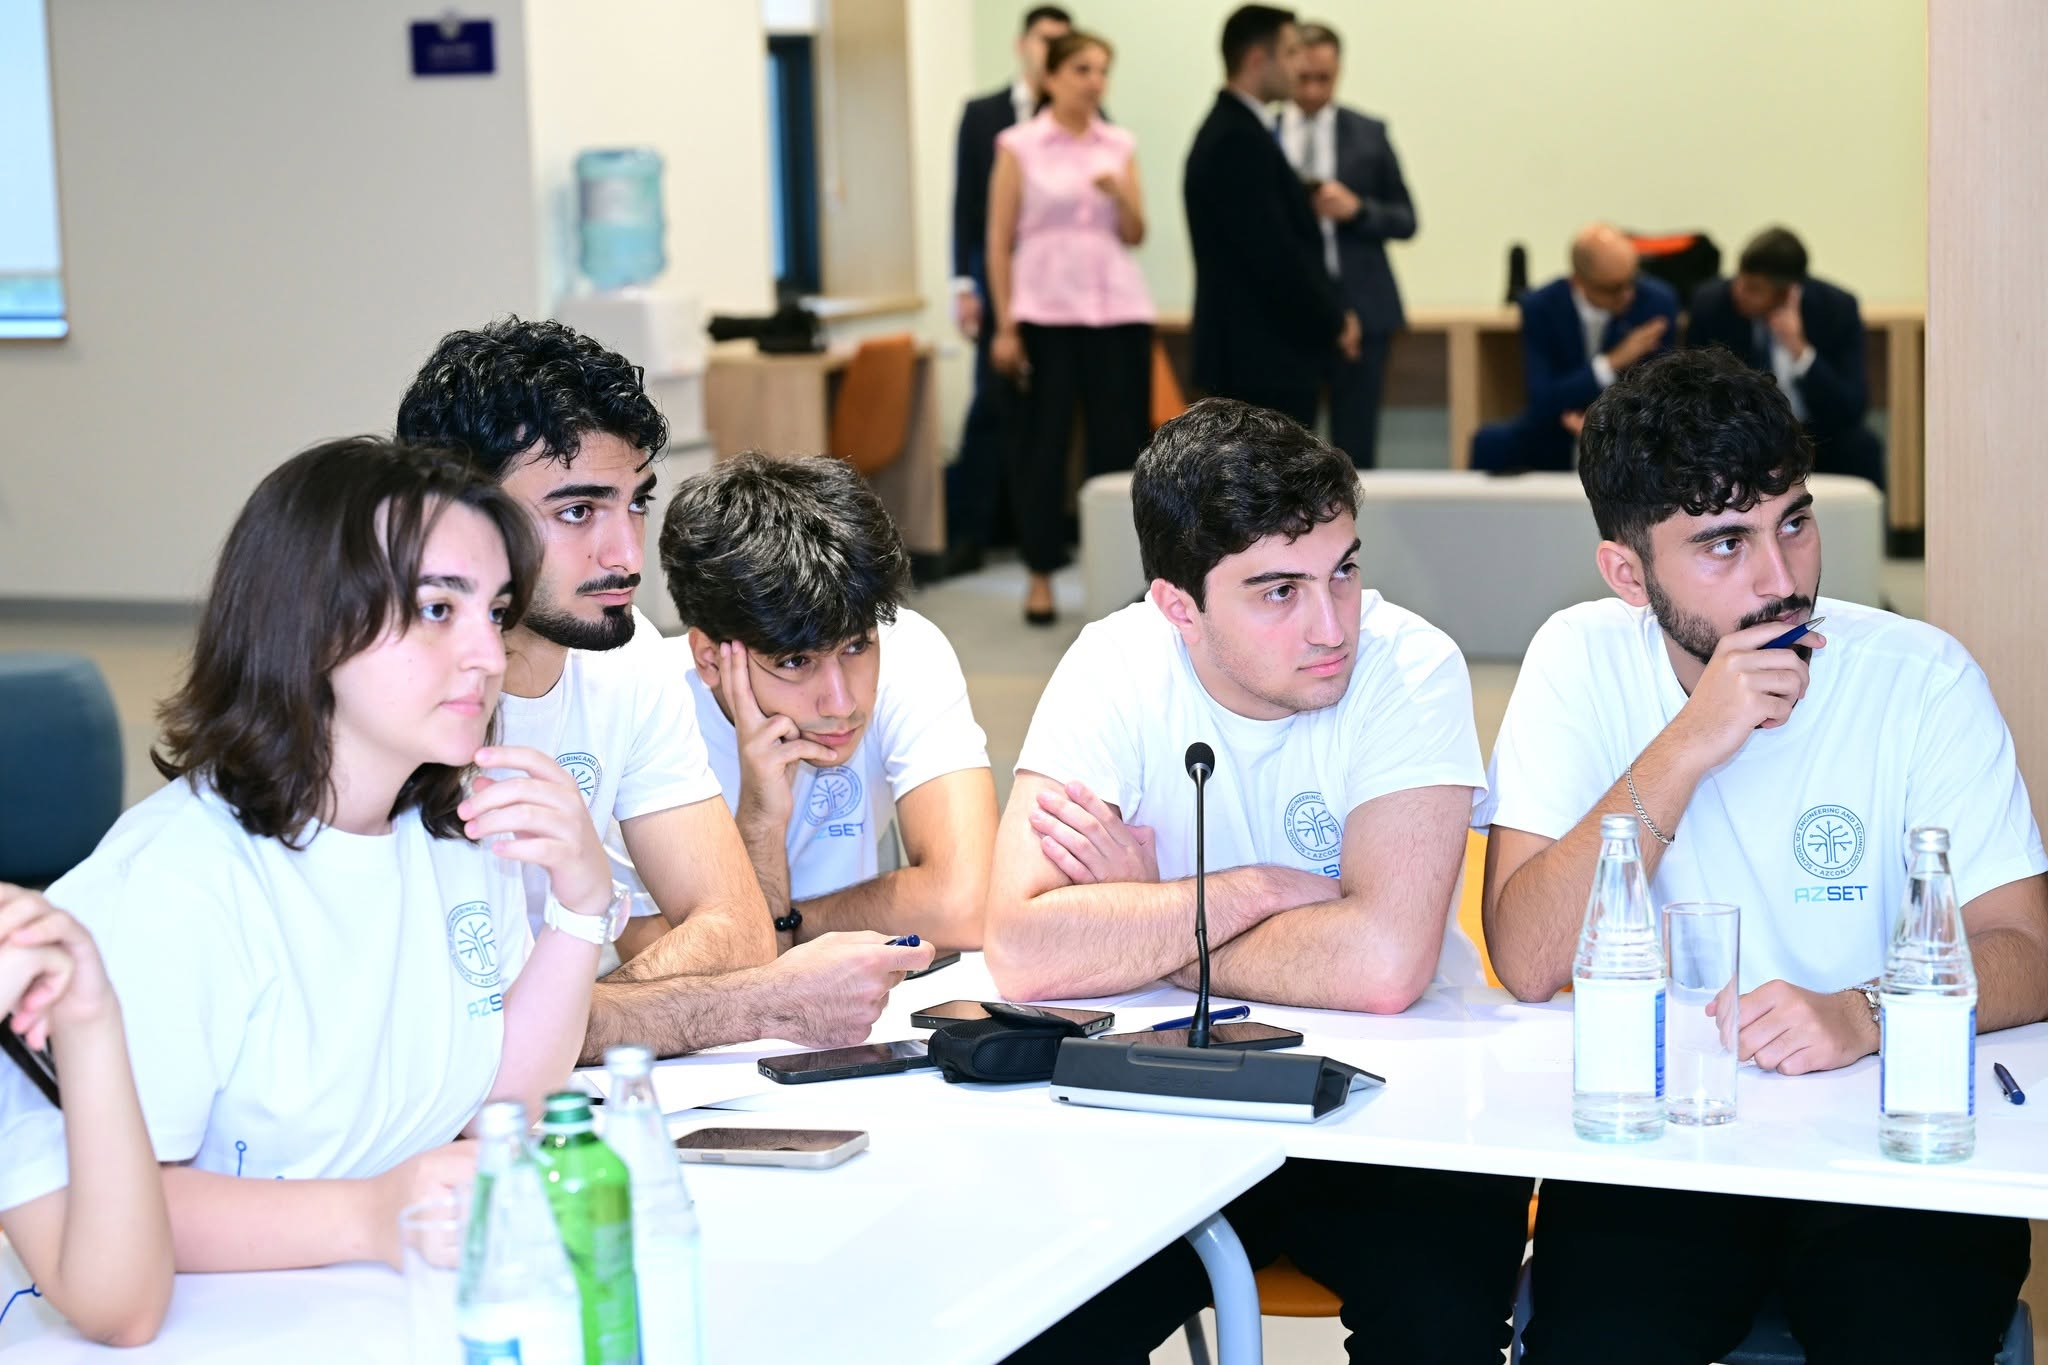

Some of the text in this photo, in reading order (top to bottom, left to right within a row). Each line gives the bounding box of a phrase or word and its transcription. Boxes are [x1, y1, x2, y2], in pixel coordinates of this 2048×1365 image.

[1288, 794, 1321, 817] ENGINEERING
[820, 822, 865, 837] SET
[1795, 807, 1864, 870] SCHOOL OF ENGINEERING AND TECHNOLOGY
[1288, 829, 1306, 853] SCHOOL
[1312, 848, 1338, 858] AZCON
[1819, 868, 1846, 877] AZCON
[1794, 885, 1869, 904] AZSET
[467, 993, 503, 1020] AZS
